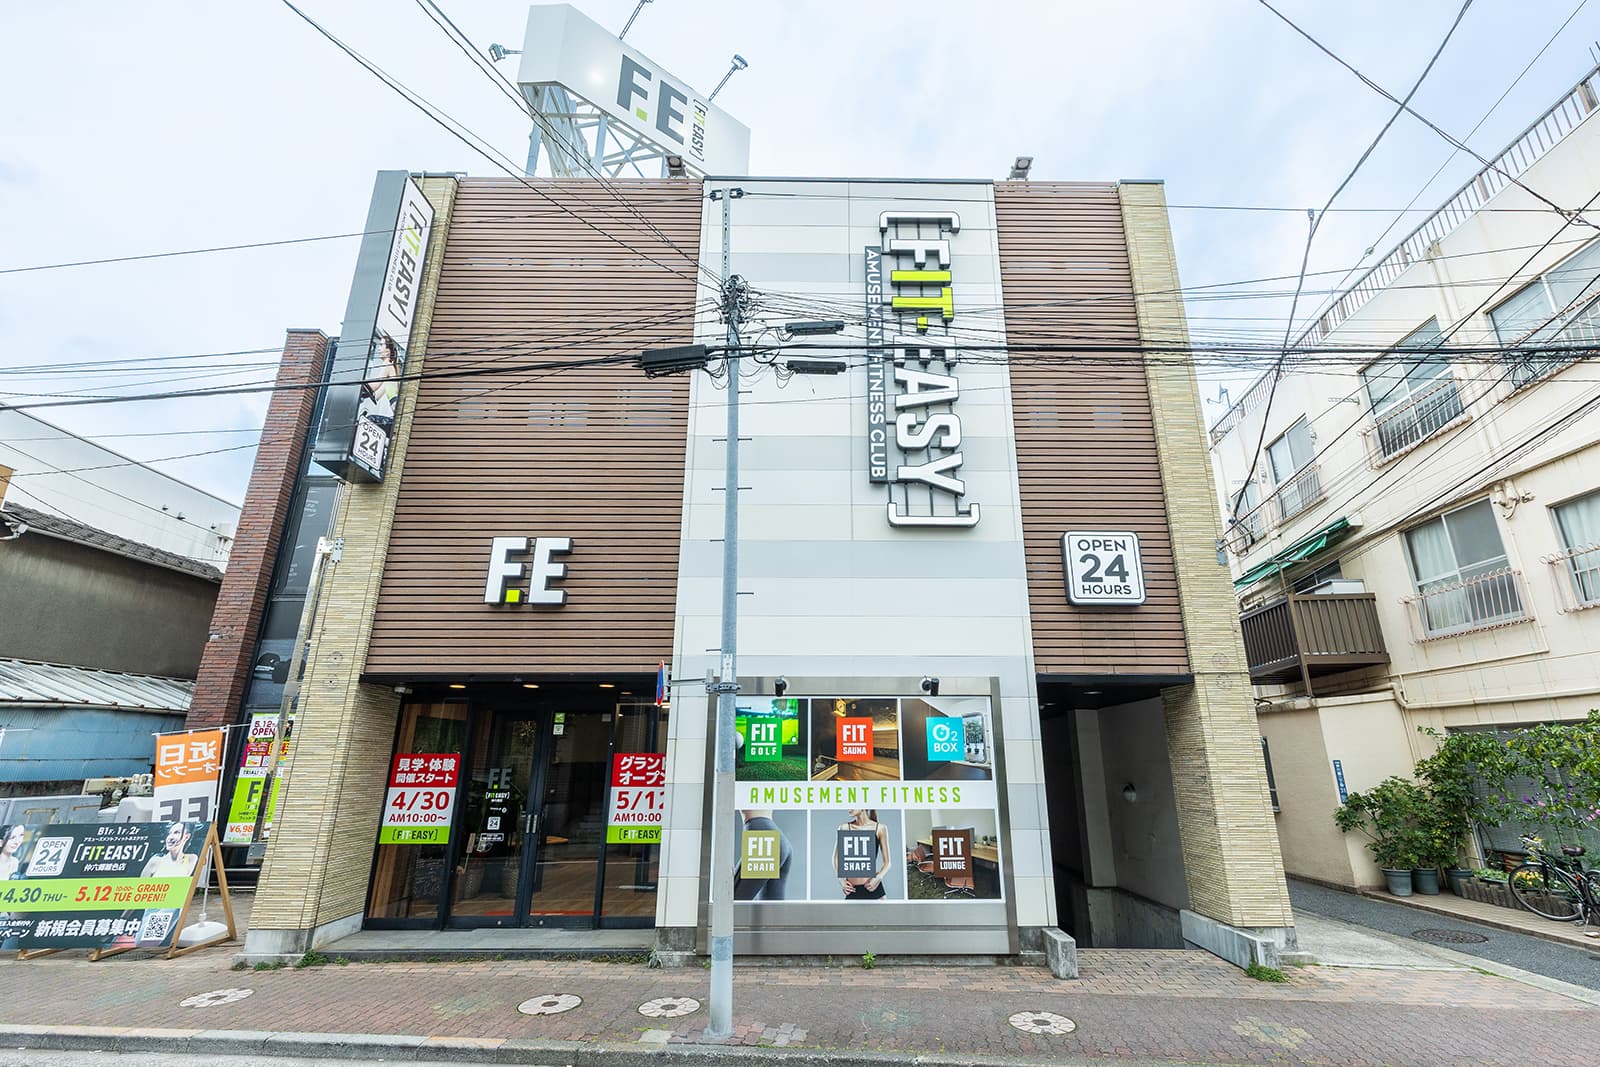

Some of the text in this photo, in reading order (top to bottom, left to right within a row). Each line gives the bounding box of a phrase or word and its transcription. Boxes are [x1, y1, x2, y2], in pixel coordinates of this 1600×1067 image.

[866, 249, 882, 346] AMUSEMENT
[362, 422, 382, 440] OPEN
[360, 431, 379, 456] 24
[358, 448, 377, 464] HOURS
[870, 429, 886, 478] CLUB
[1077, 539, 1127, 551] OPEN
[1079, 553, 1130, 583] 24
[1082, 584, 1132, 595] HOURS
[251, 727, 276, 736] OPEN
[751, 723, 778, 741] FIT
[842, 724, 867, 742] FIT
[750, 747, 777, 756] GOLF
[842, 746, 867, 755] SAUNA
[934, 742, 959, 752] BOX
[397, 757, 456, 772] 見学・体験
[395, 773, 453, 784] 開催スタート
[391, 791, 450, 811] 4/30
[750, 786, 962, 804] AMUSEMENT FITNESS
[230, 824, 255, 833] ¥6,98
[42, 840, 68, 848] OPEN
[747, 836, 775, 856] FIT
[843, 836, 870, 856] FIT
[938, 837, 964, 856] FIT
[35, 848, 63, 865] 24
[33, 865, 57, 873] HOURS
[747, 862, 775, 871] CHAIR
[843, 862, 871, 871] SHAPE
[939, 861, 966, 870] LOUNGE
[3, 887, 42, 903] 4.30
[74, 885, 112, 902] 5.12
[113, 892, 132, 902] TUE
[134, 893, 167, 903] OPEN!!
[137, 883, 170, 893] GRAND
[33, 918, 142, 938] 新規会員募集中
